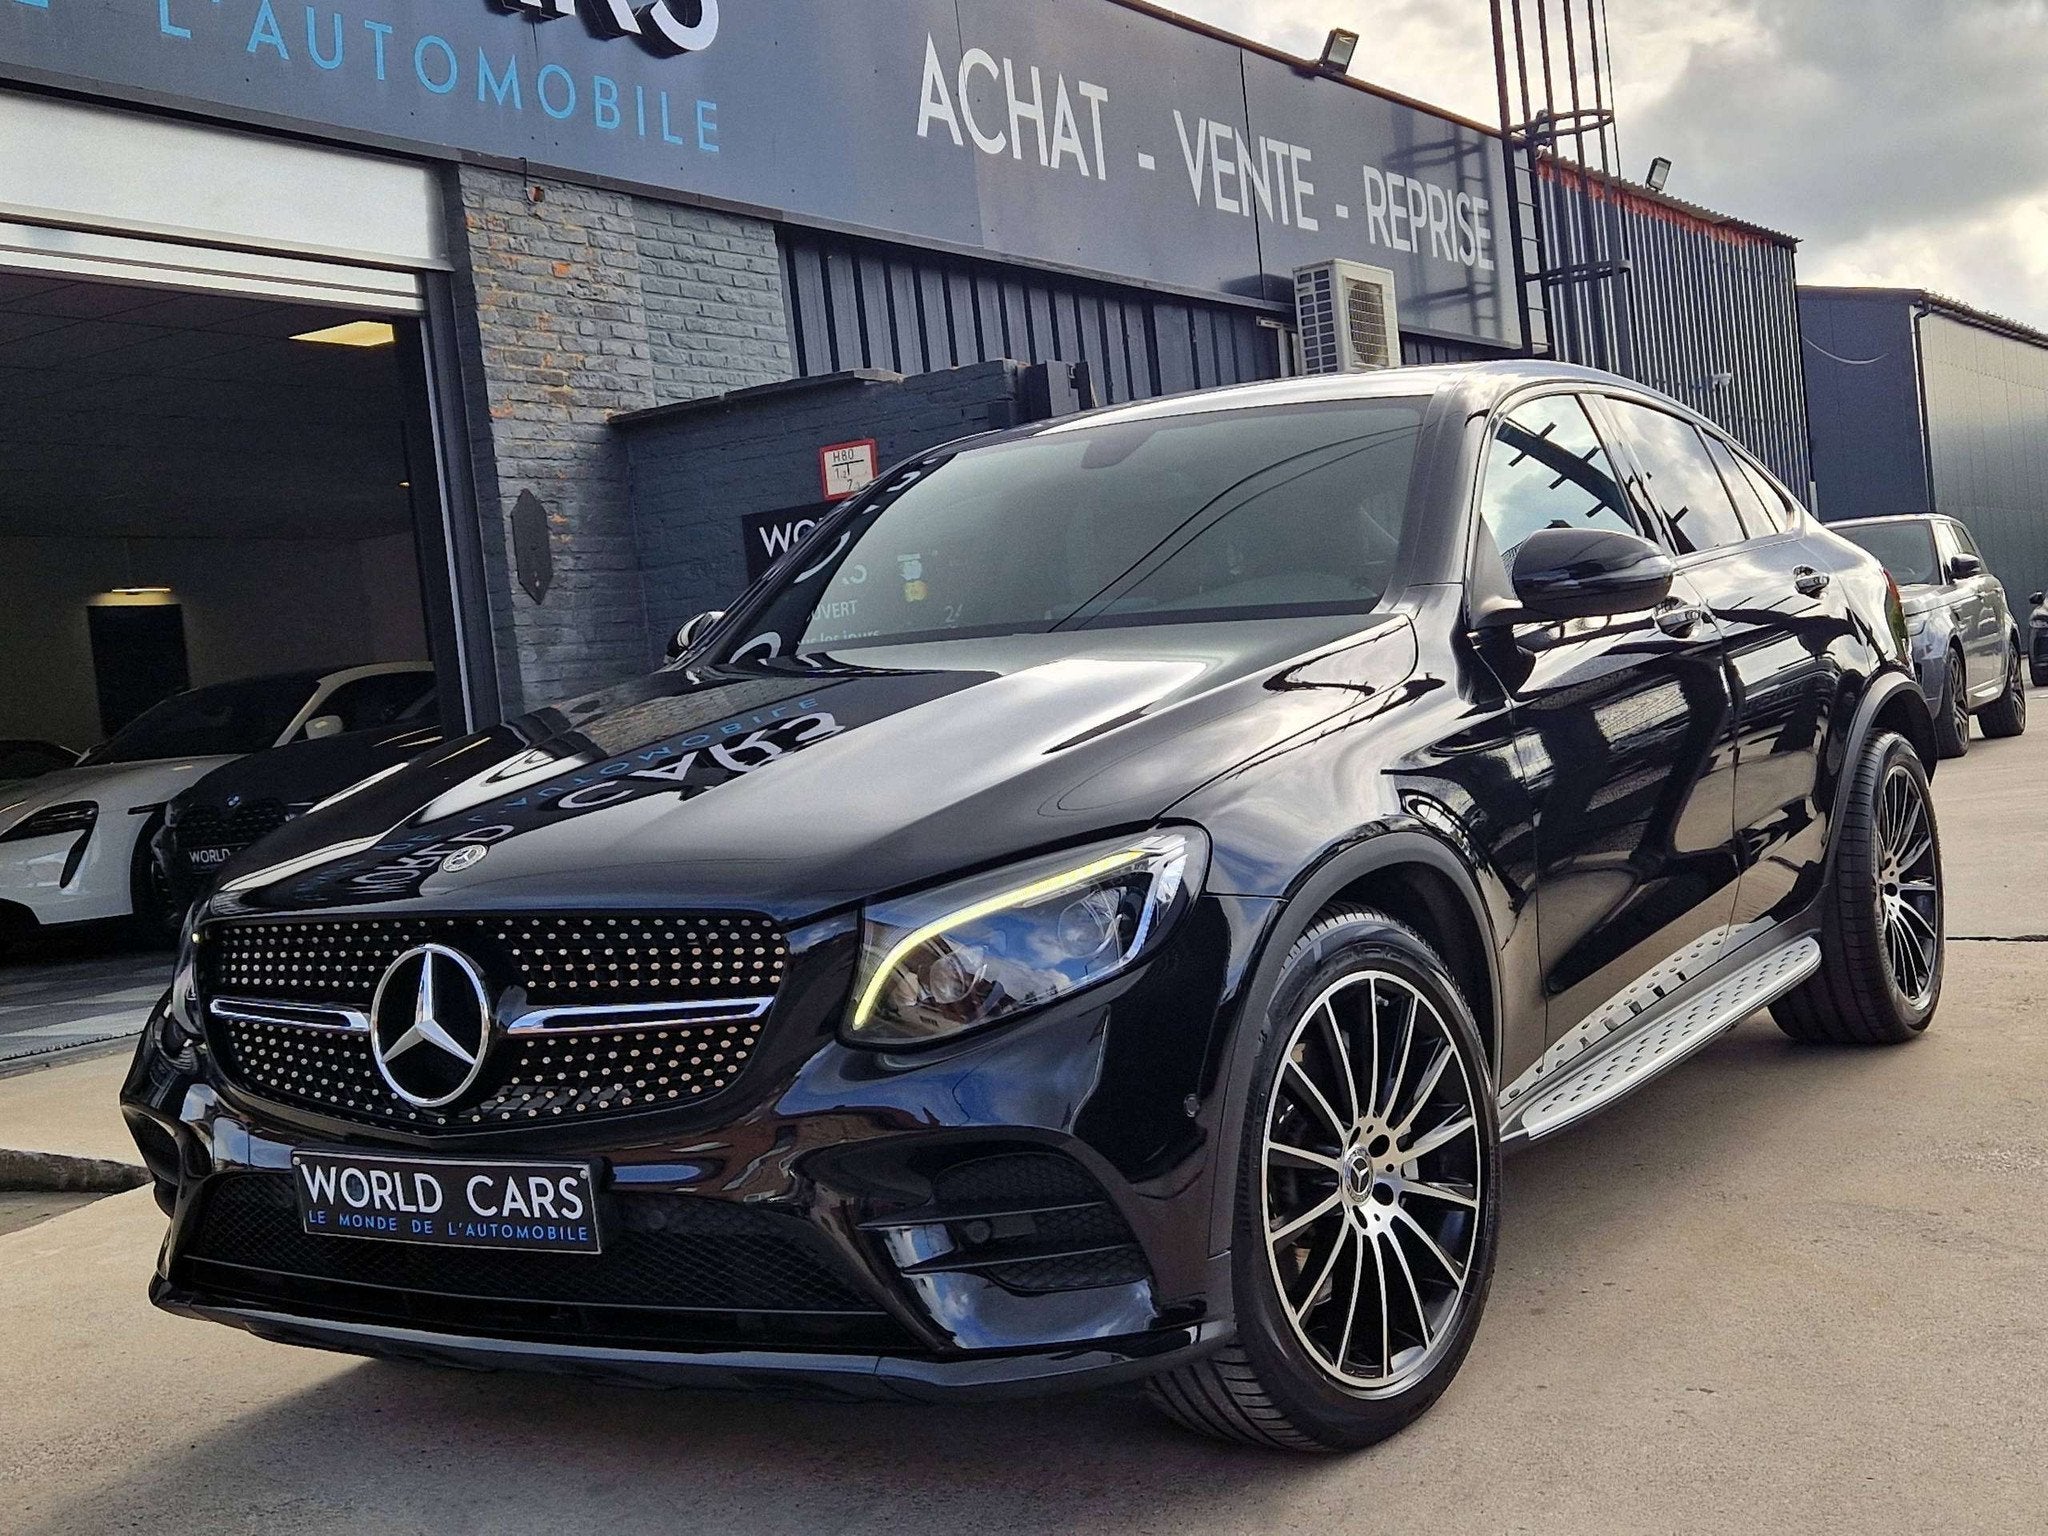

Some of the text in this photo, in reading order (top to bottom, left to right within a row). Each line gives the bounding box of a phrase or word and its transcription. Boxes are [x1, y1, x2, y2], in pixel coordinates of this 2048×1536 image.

[916, 32, 1494, 270] ACHAT - VENTE - REPRISE
[832, 449, 854, 462] H80
[300, 1164, 584, 1220] WORLD CARS
[308, 1210, 589, 1241] LE MONDE DE L'AUTOMOBILE
